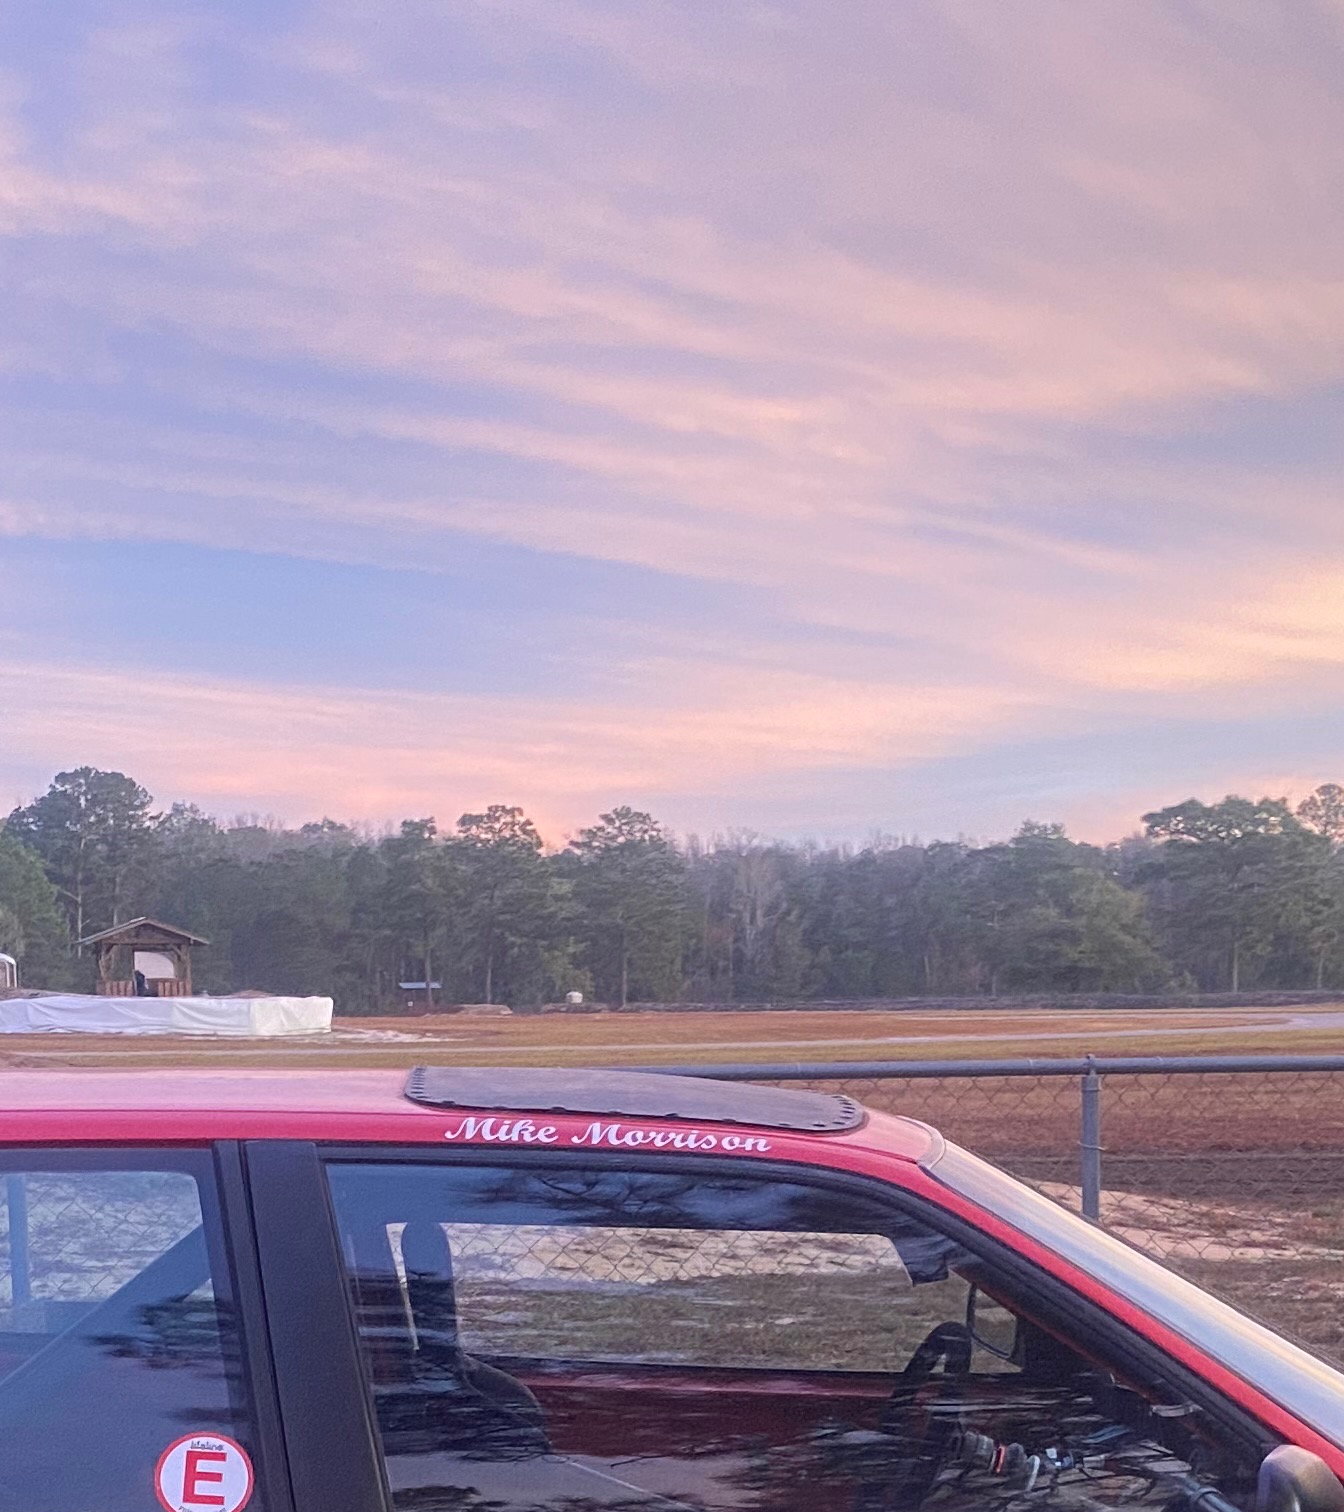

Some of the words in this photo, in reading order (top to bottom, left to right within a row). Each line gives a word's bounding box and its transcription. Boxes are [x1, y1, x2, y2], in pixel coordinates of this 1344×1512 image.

[444, 1116, 559, 1144] Mike
[571, 1122, 772, 1152] Morrison
[182, 1450, 227, 1505] E
